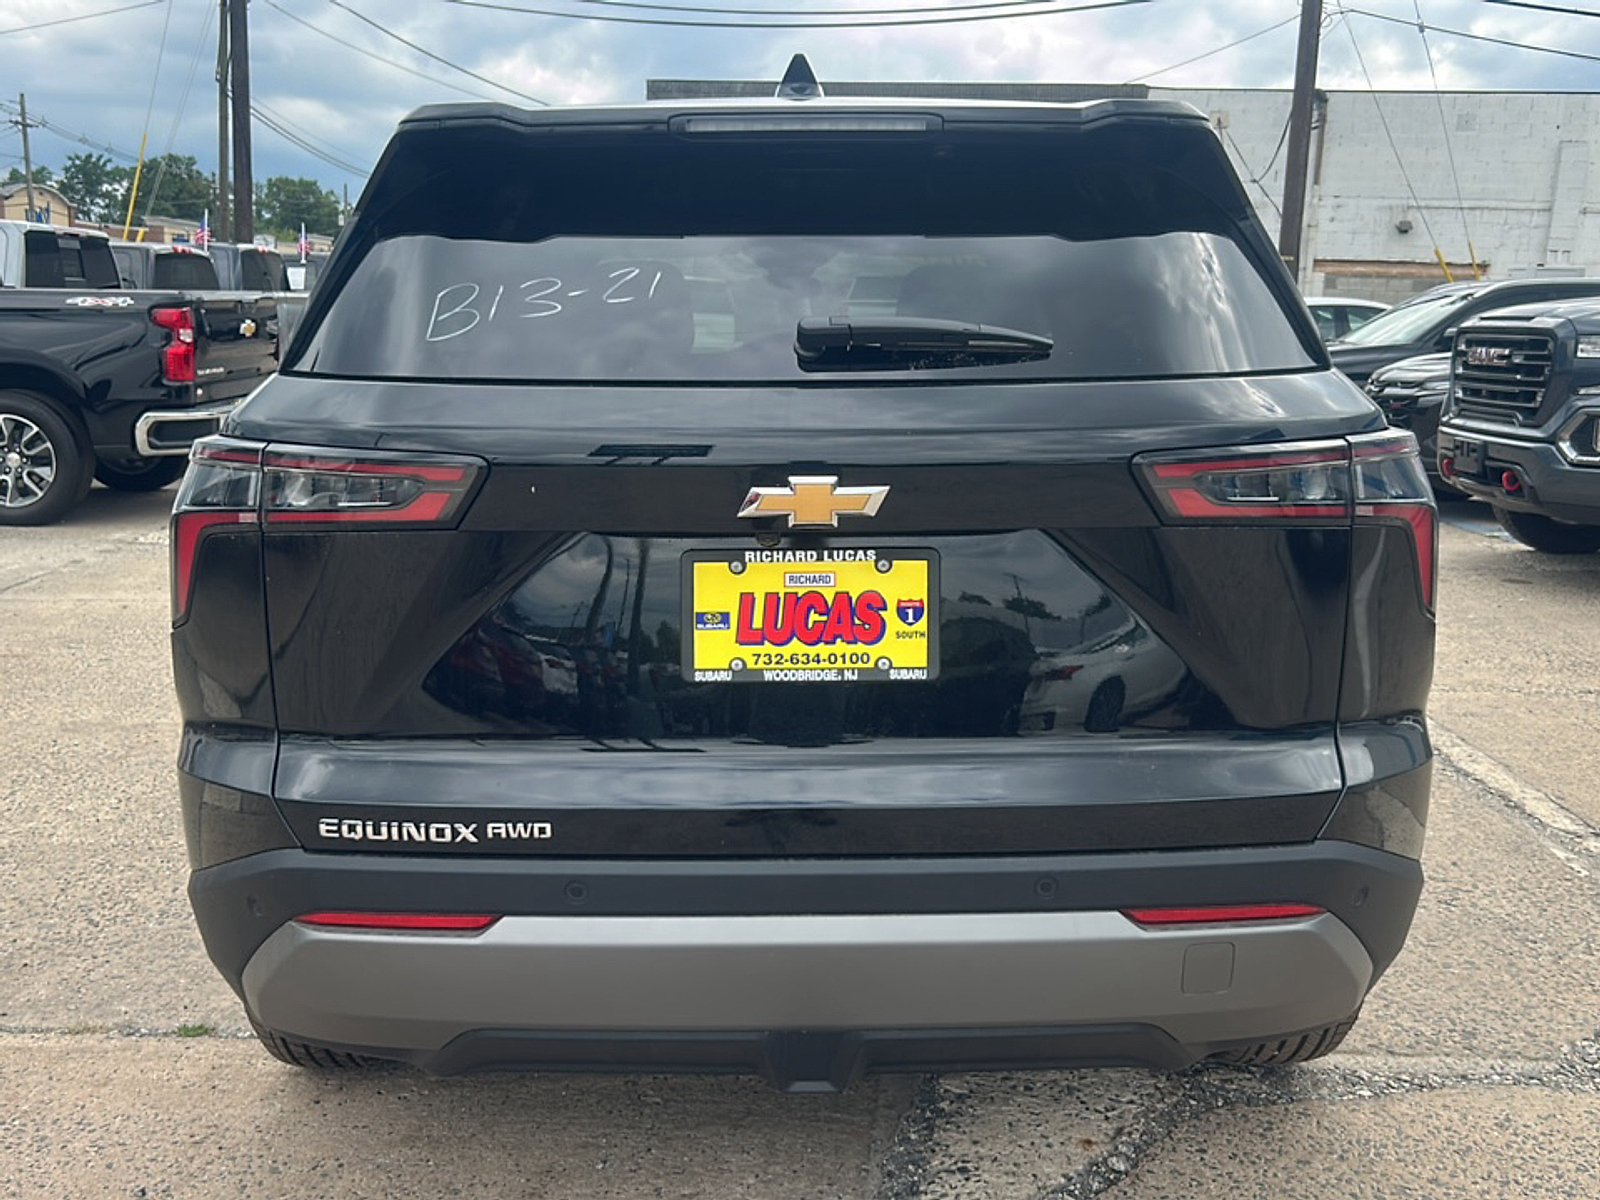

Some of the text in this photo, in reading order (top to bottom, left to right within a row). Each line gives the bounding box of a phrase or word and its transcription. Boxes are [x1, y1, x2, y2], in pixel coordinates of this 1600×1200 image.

[744, 549, 877, 563] RICHARD LUCAS
[788, 574, 832, 585] RICHARD
[736, 590, 888, 647] LUCAS
[904, 607, 916, 623] 1
[895, 630, 926, 640] SOUTH
[752, 652, 871, 666] 732-634-0100
[694, 670, 733, 682] SUBARU
[843, 668, 859, 681] NJ
[889, 669, 928, 680] SUBARU
[318, 817, 553, 844] EQUINOX AWD
